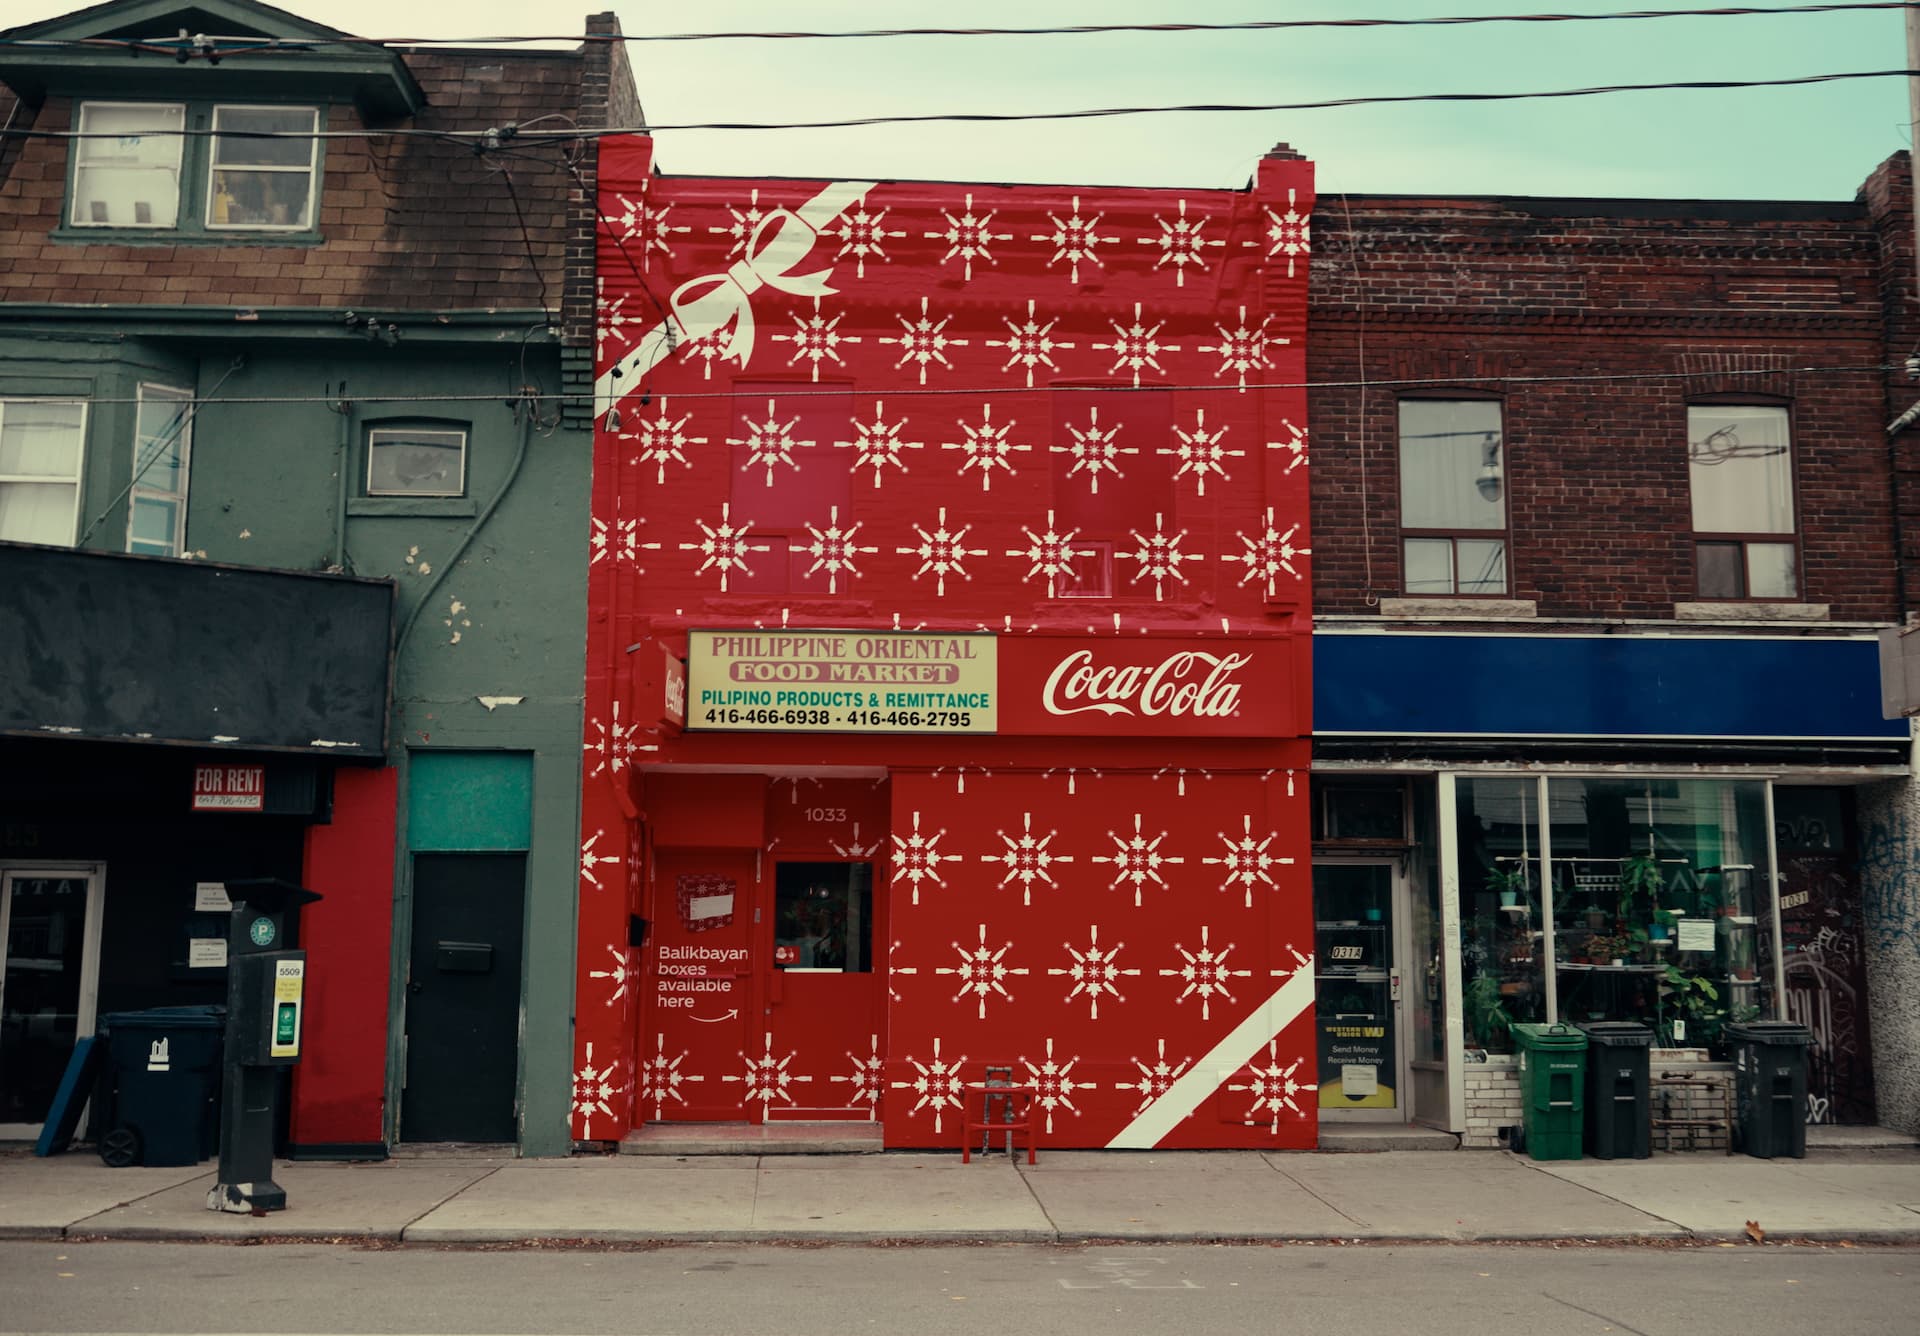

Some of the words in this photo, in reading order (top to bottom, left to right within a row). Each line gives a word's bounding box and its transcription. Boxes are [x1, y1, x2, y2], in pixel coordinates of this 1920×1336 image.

[712, 636, 847, 658] PHILIPPINE
[855, 638, 977, 660] ORIENTAL
[737, 663, 820, 681] FOOD
[830, 664, 954, 683] MARKET
[1042, 649, 1254, 717] Coca-Cola
[701, 690, 771, 706] PILIPINO
[776, 691, 864, 708] PRODUCTS
[868, 692, 880, 708] &
[885, 693, 989, 709] REMITTANCE
[705, 709, 830, 725] 416-466-6938
[847, 711, 971, 727] 416-466-2795
[195, 768, 223, 792] FOR
[227, 769, 262, 793] RENT
[804, 807, 847, 822] 1033
[1782, 891, 1808, 908] 1031
[659, 946, 748, 962] Balikbayan
[279, 967, 301, 976] 5509
[658, 962, 707, 975] boxes
[658, 978, 732, 992] available
[658, 994, 695, 1008] here
[1332, 1045, 1352, 1054] Send
[1353, 1045, 1379, 1055] Money
[1327, 1056, 1357, 1065] Receive
[1358, 1056, 1384, 1066] Money
